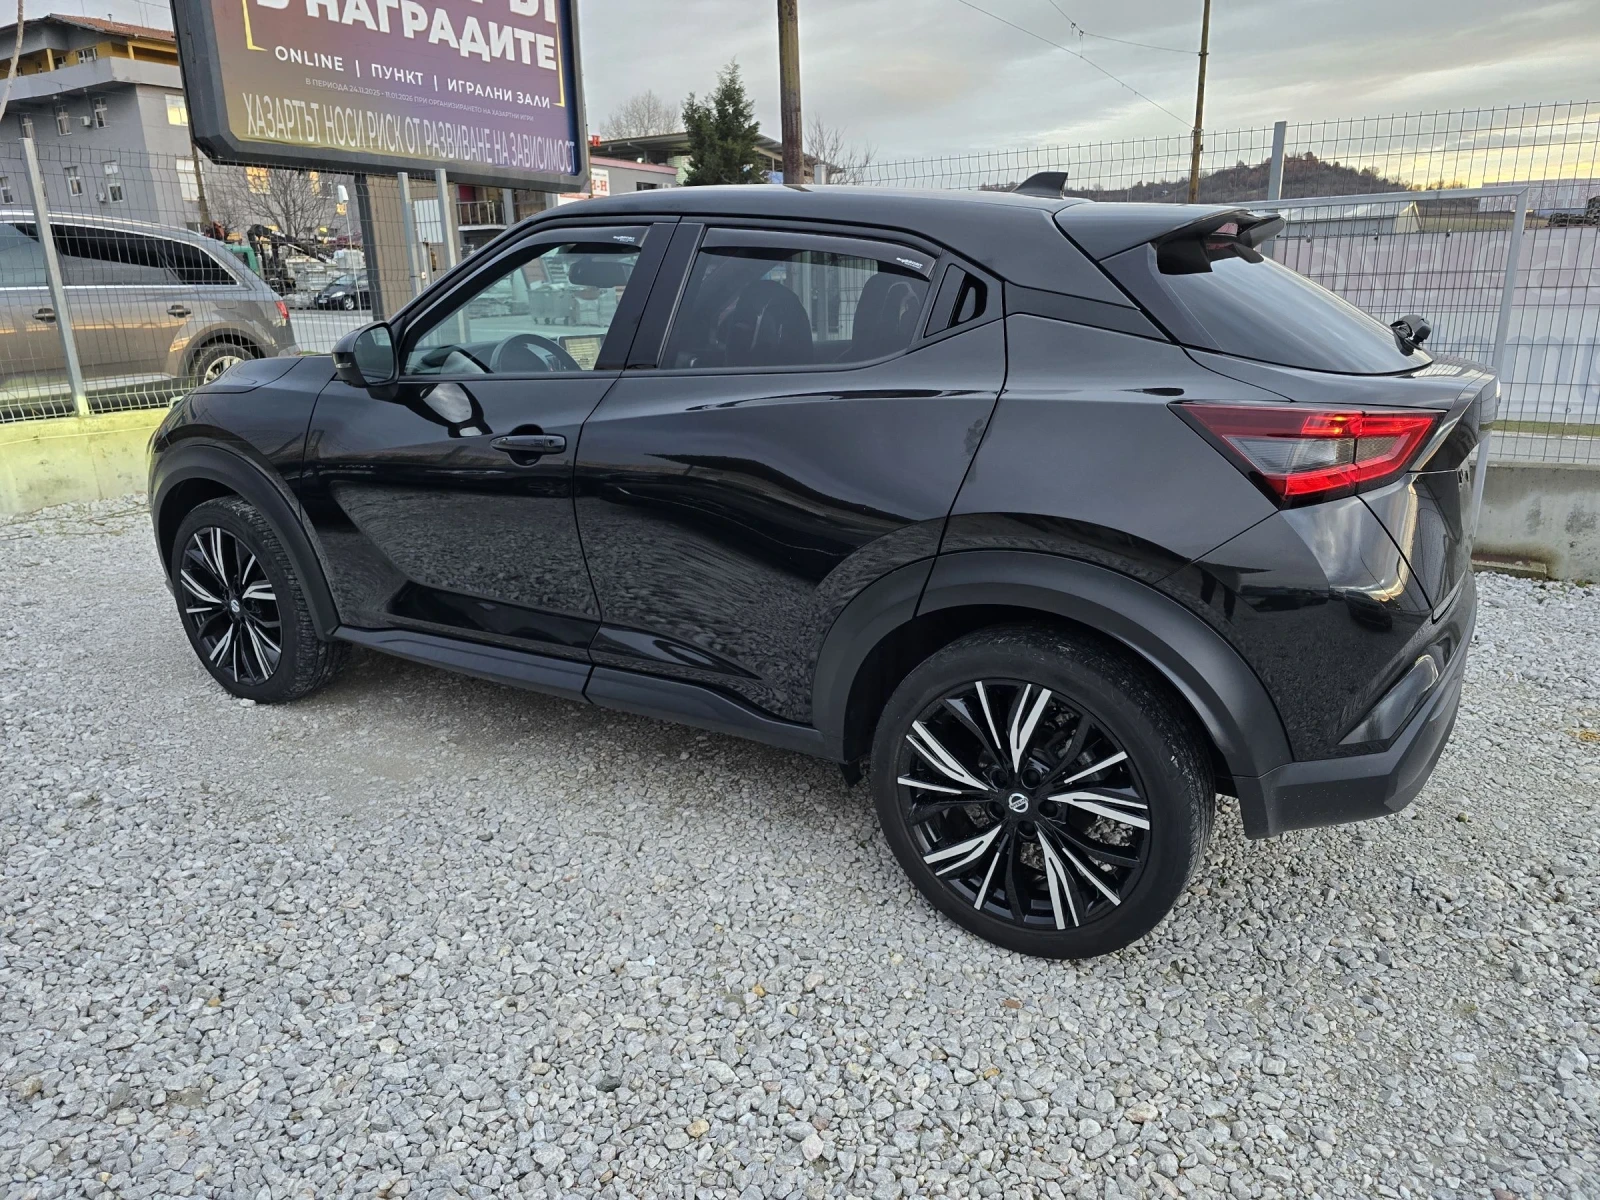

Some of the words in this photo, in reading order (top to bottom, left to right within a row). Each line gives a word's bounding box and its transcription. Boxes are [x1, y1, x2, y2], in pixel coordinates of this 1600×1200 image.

[275, 46, 344, 71] ONLINE
[371, 63, 423, 85] ПУНКТ
[448, 78, 512, 102] ИГРАЛНИ
[516, 91, 550, 108] ЗАЛИ
[305, 77, 311, 85] В
[312, 79, 348, 92] ПЕРИОДА
[349, 85, 381, 96] 24.11.2025
[414, 96, 427, 104] ПРИ
[428, 98, 482, 113] ОРГАНИЗИРАНЕТО
[491, 110, 519, 120] ХАЗАРТНИ
[242, 92, 321, 143] ХАЗАРТЪТ
[322, 104, 366, 148] НОСИ
[366, 110, 404, 153] РИСК
[405, 116, 421, 155] ОТ
[423, 119, 493, 163] РАЗВИВАНЕ
[493, 129, 510, 165] НА
[510, 132, 575, 173] ЗАВИСИМОСТ
